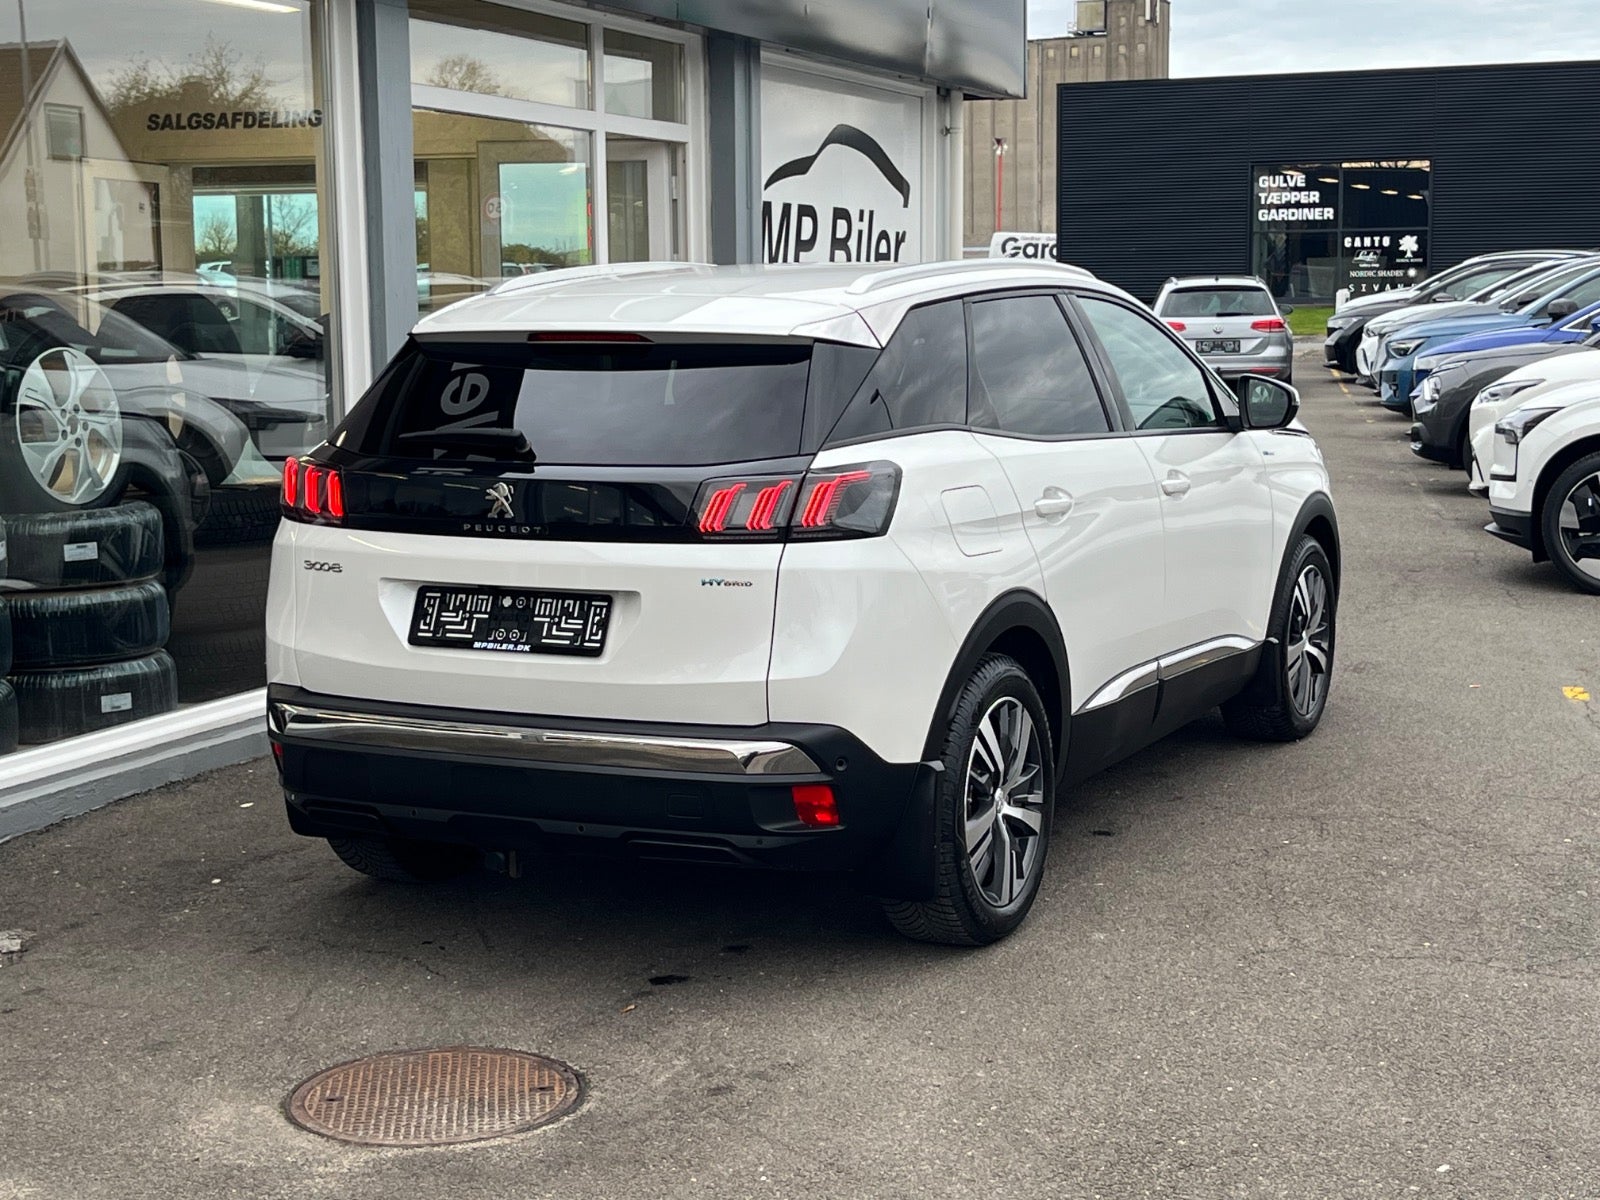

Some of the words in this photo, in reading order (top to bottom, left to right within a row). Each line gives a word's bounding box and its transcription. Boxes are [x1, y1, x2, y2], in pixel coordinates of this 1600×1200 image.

[147, 109, 322, 131] SALGSAFDELING
[1258, 175, 1306, 188] GULVE
[1258, 191, 1320, 204] TÆPPER
[1258, 207, 1334, 221] GARDINER
[762, 201, 818, 264] MP
[829, 206, 907, 262] Biler
[463, 523, 541, 534] PEUGEOT
[304, 560, 342, 573] 3008
[473, 641, 531, 652] MPBILER.DK
